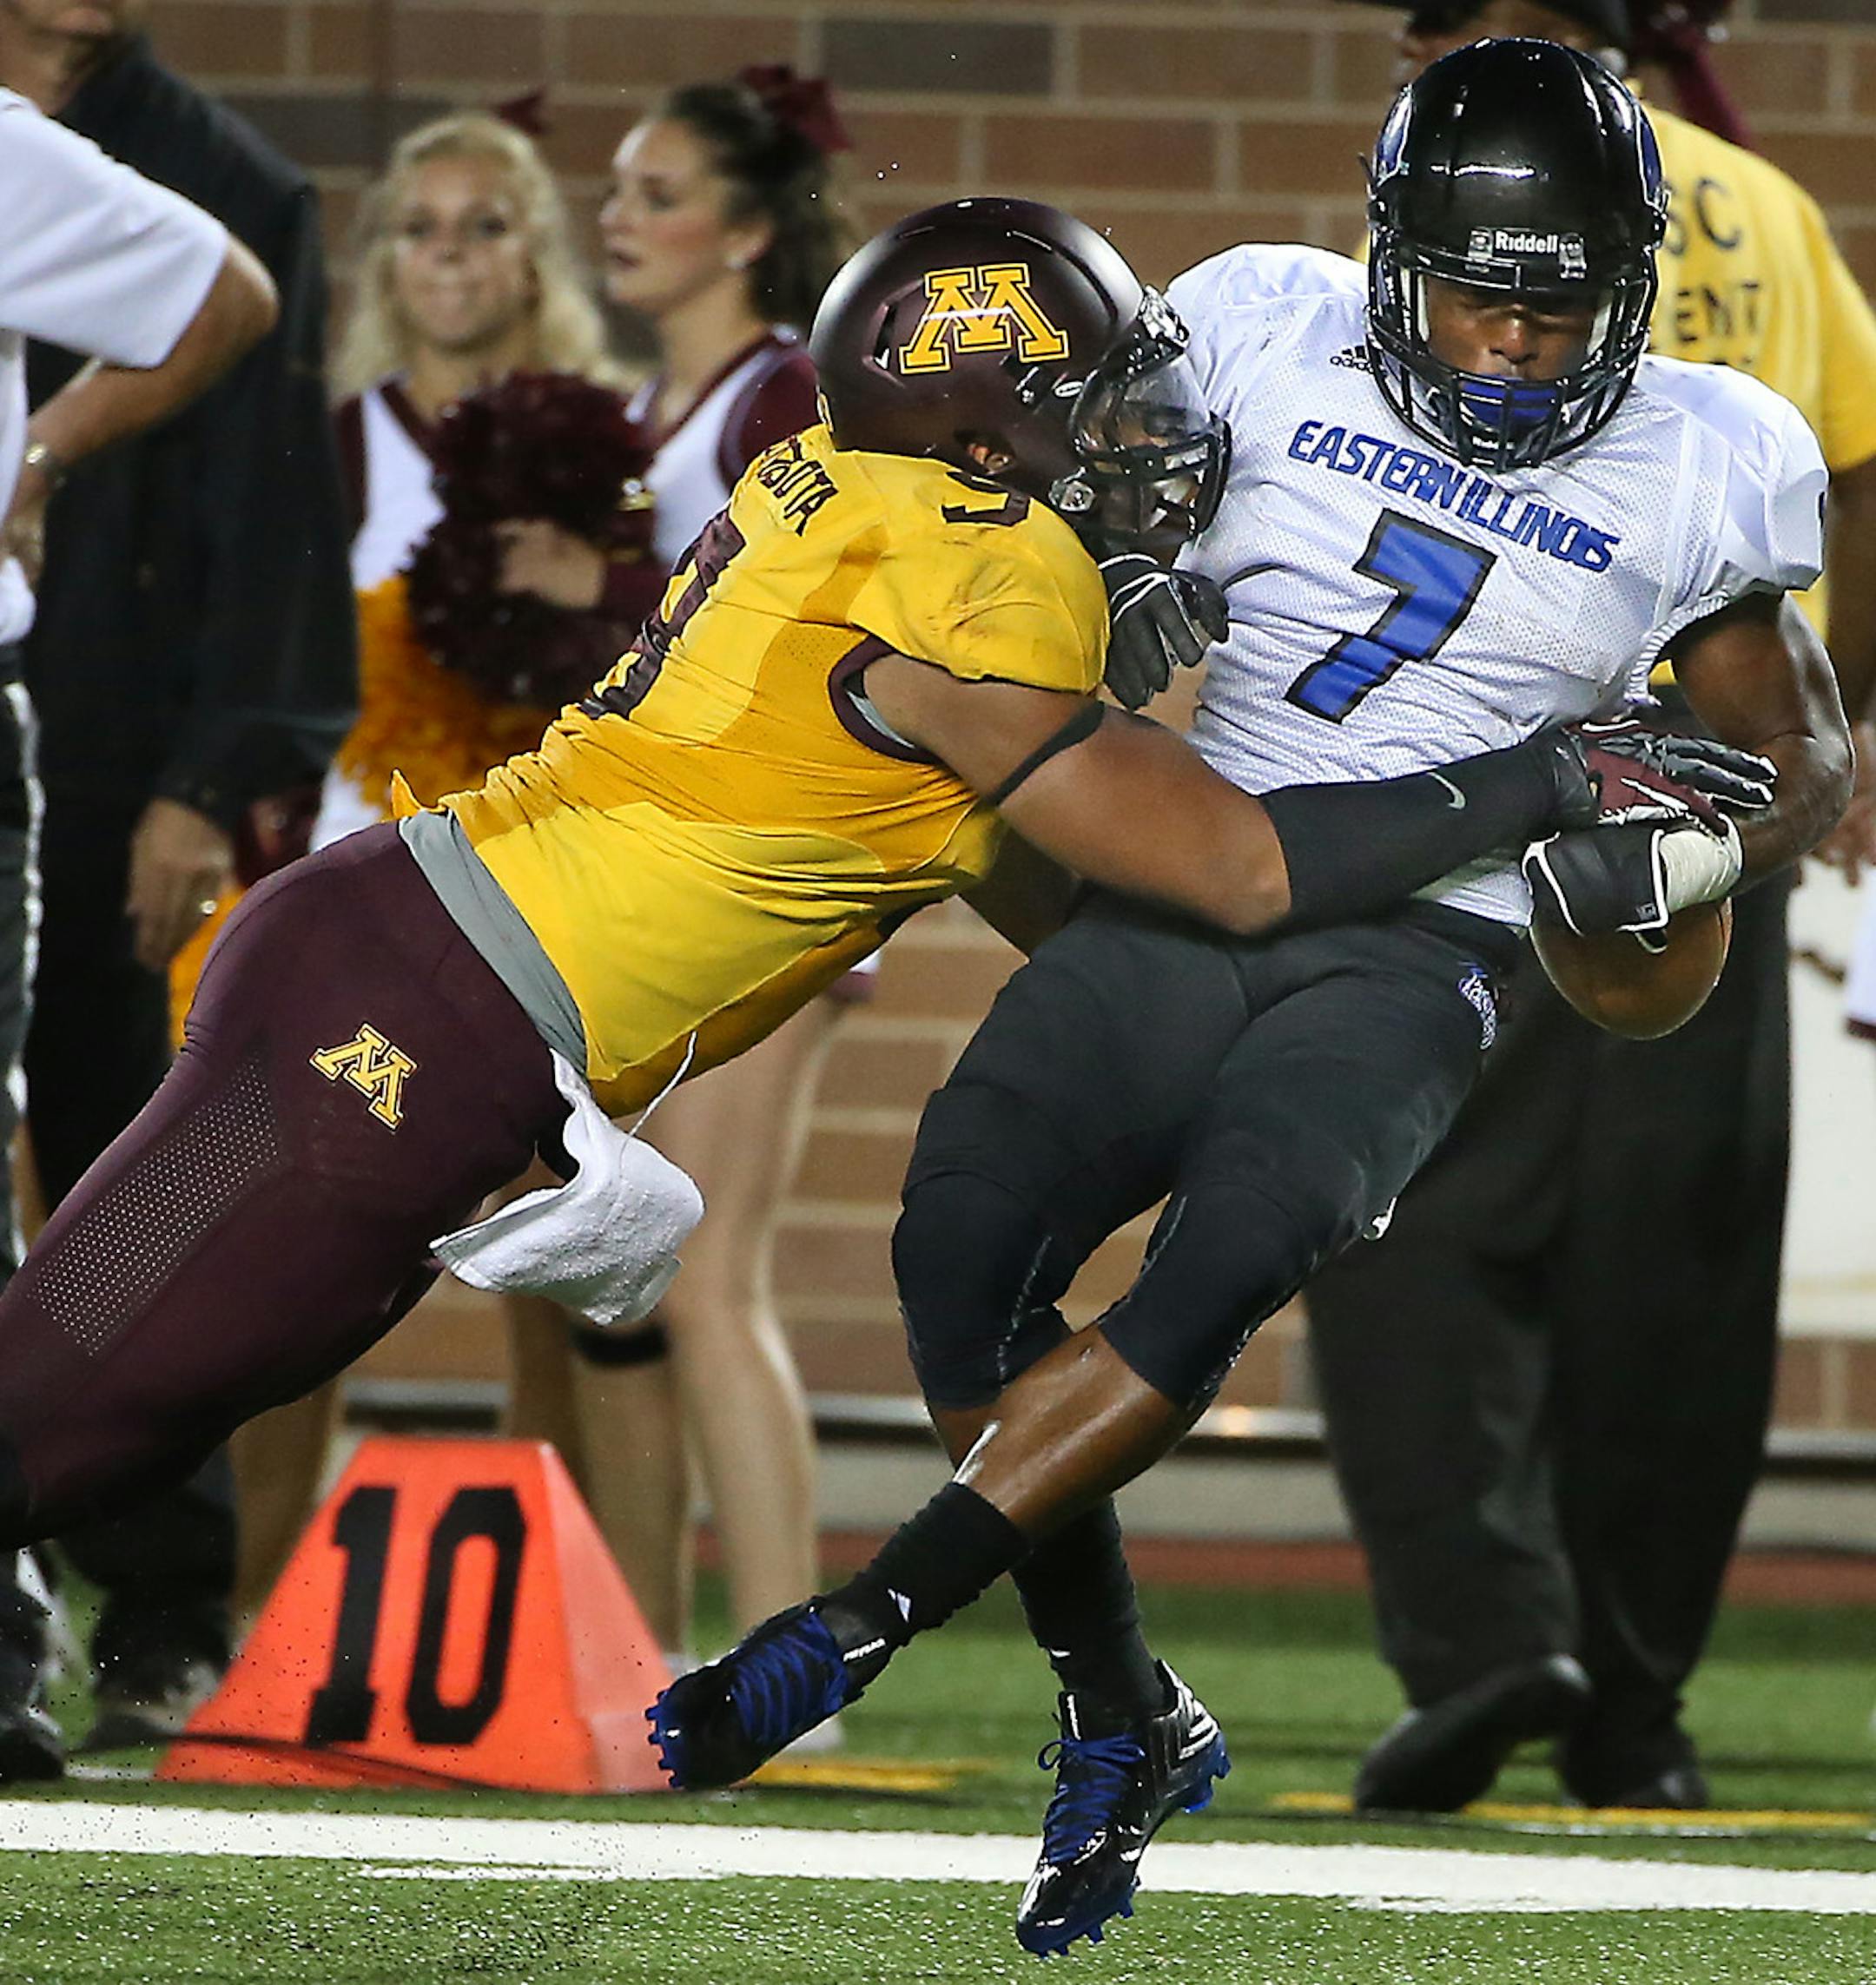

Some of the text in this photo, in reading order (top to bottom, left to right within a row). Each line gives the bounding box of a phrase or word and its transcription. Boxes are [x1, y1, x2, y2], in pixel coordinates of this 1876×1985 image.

[1494, 229, 1559, 254] Riddell
[899, 262, 1069, 374] M
[1287, 419, 1470, 511] EASTERN
[1284, 506, 1497, 724] 7
[309, 1021, 418, 1131] M
[303, 1484, 526, 1749] 10
